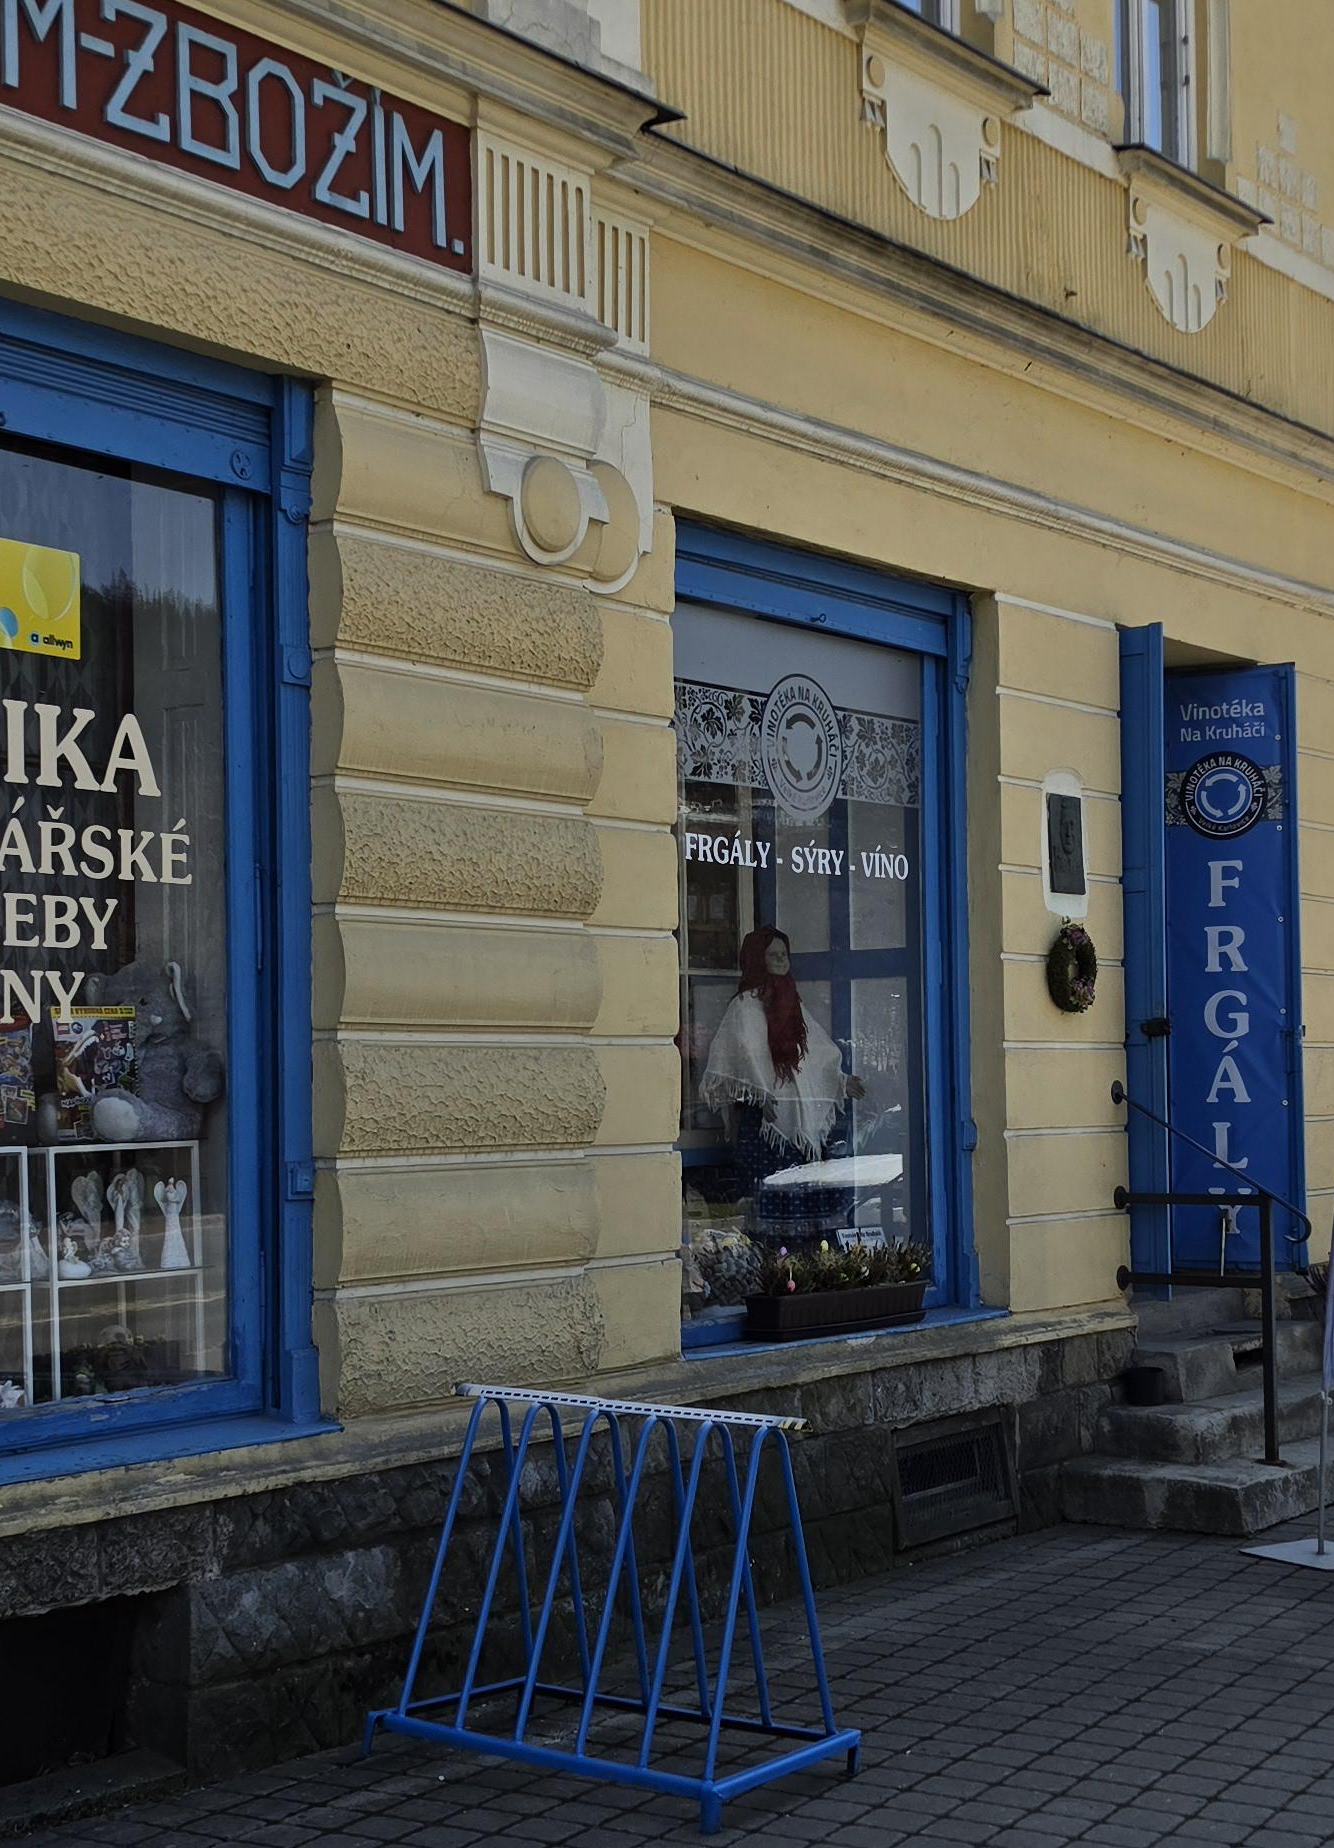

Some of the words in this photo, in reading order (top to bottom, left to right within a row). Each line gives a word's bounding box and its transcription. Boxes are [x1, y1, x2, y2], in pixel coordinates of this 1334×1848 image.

[43, 635, 73, 650] allwyn
[798, 686, 810, 701] NA
[1180, 700, 1265, 720] Vinotéka
[1181, 728, 1201, 742] Na
[1206, 722, 1265, 740] Kruháči
[1186, 757, 1217, 801] VINOTÉKA
[1218, 756, 1232, 766] NA
[1234, 758, 1265, 797] KRUHÁČI
[685, 831, 770, 869] FRGÁLY
[791, 840, 844, 876] SÝRY
[861, 845, 909, 880] VÍNO
